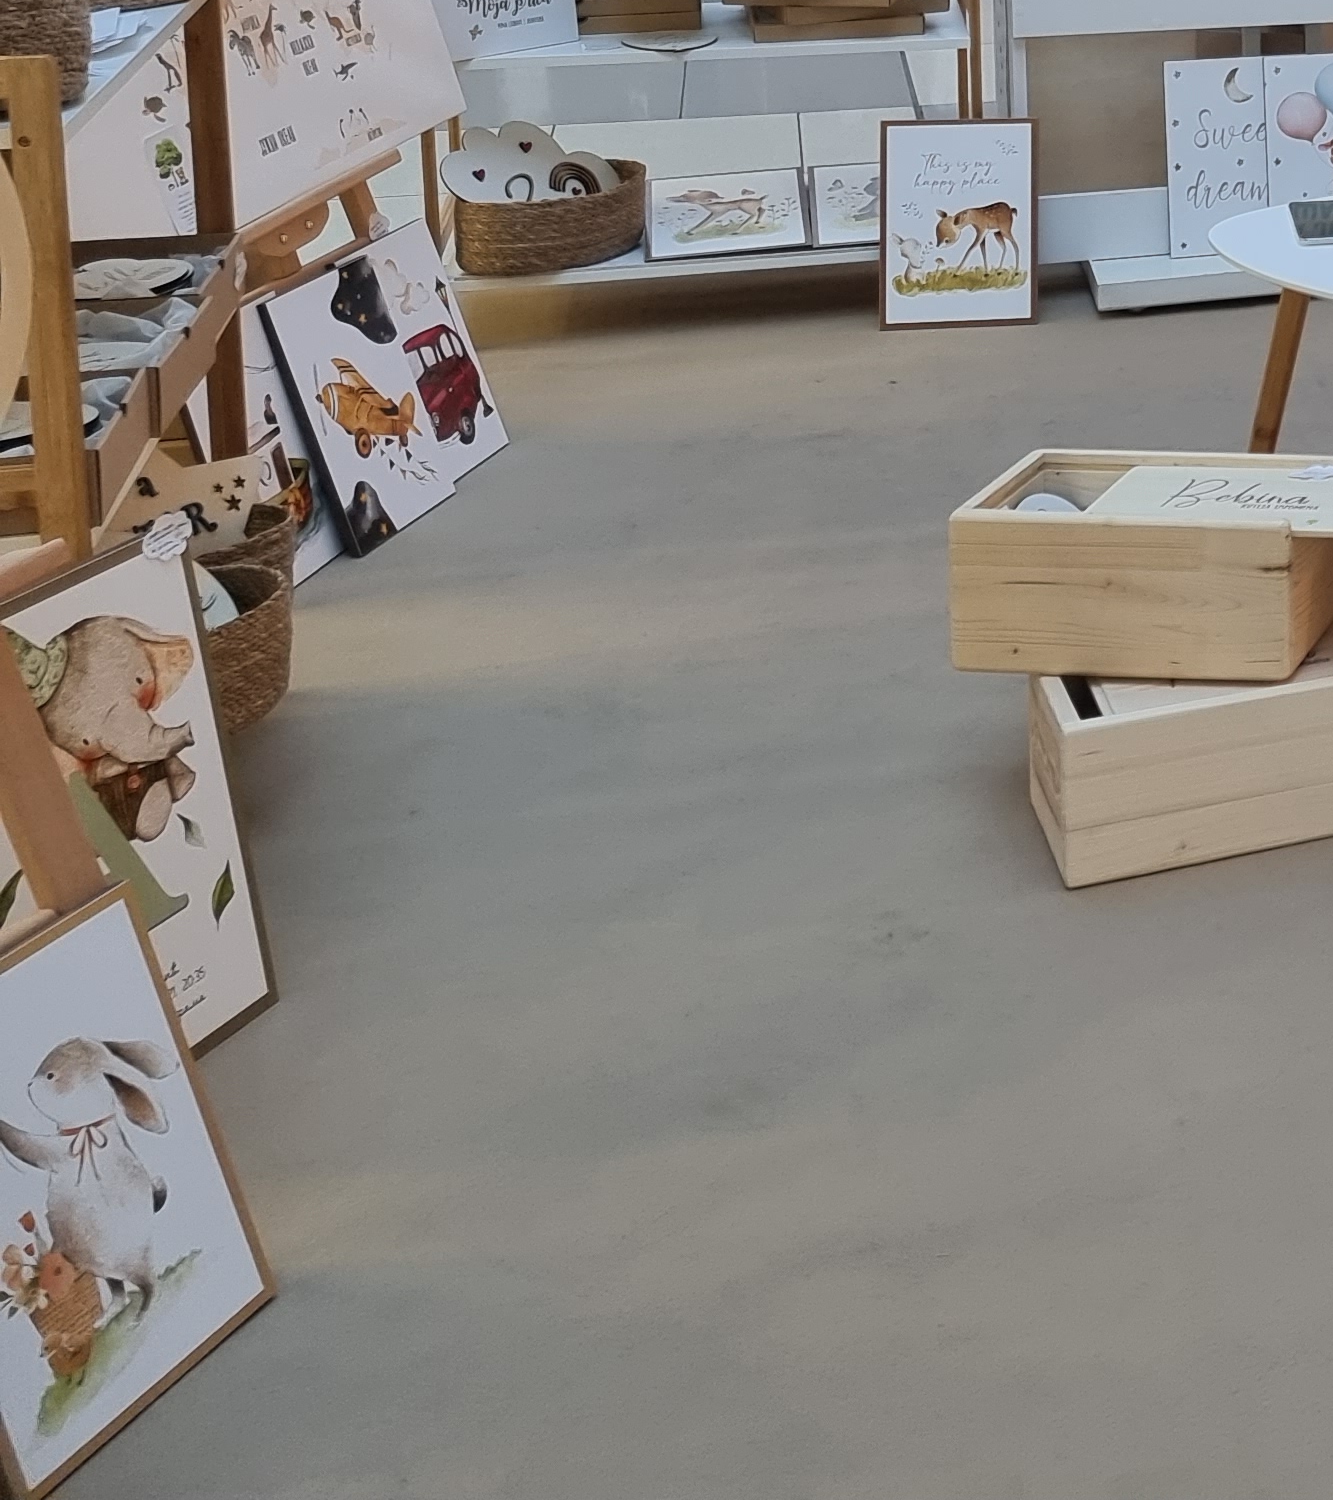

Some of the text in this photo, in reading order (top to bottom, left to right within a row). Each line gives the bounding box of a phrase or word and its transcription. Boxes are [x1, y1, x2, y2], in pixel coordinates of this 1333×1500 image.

[1193, 107, 1266, 151] Swee
[921, 153, 995, 177] This is my
[913, 171, 1001, 196] happy place
[1160, 478, 1311, 510] Bebina
